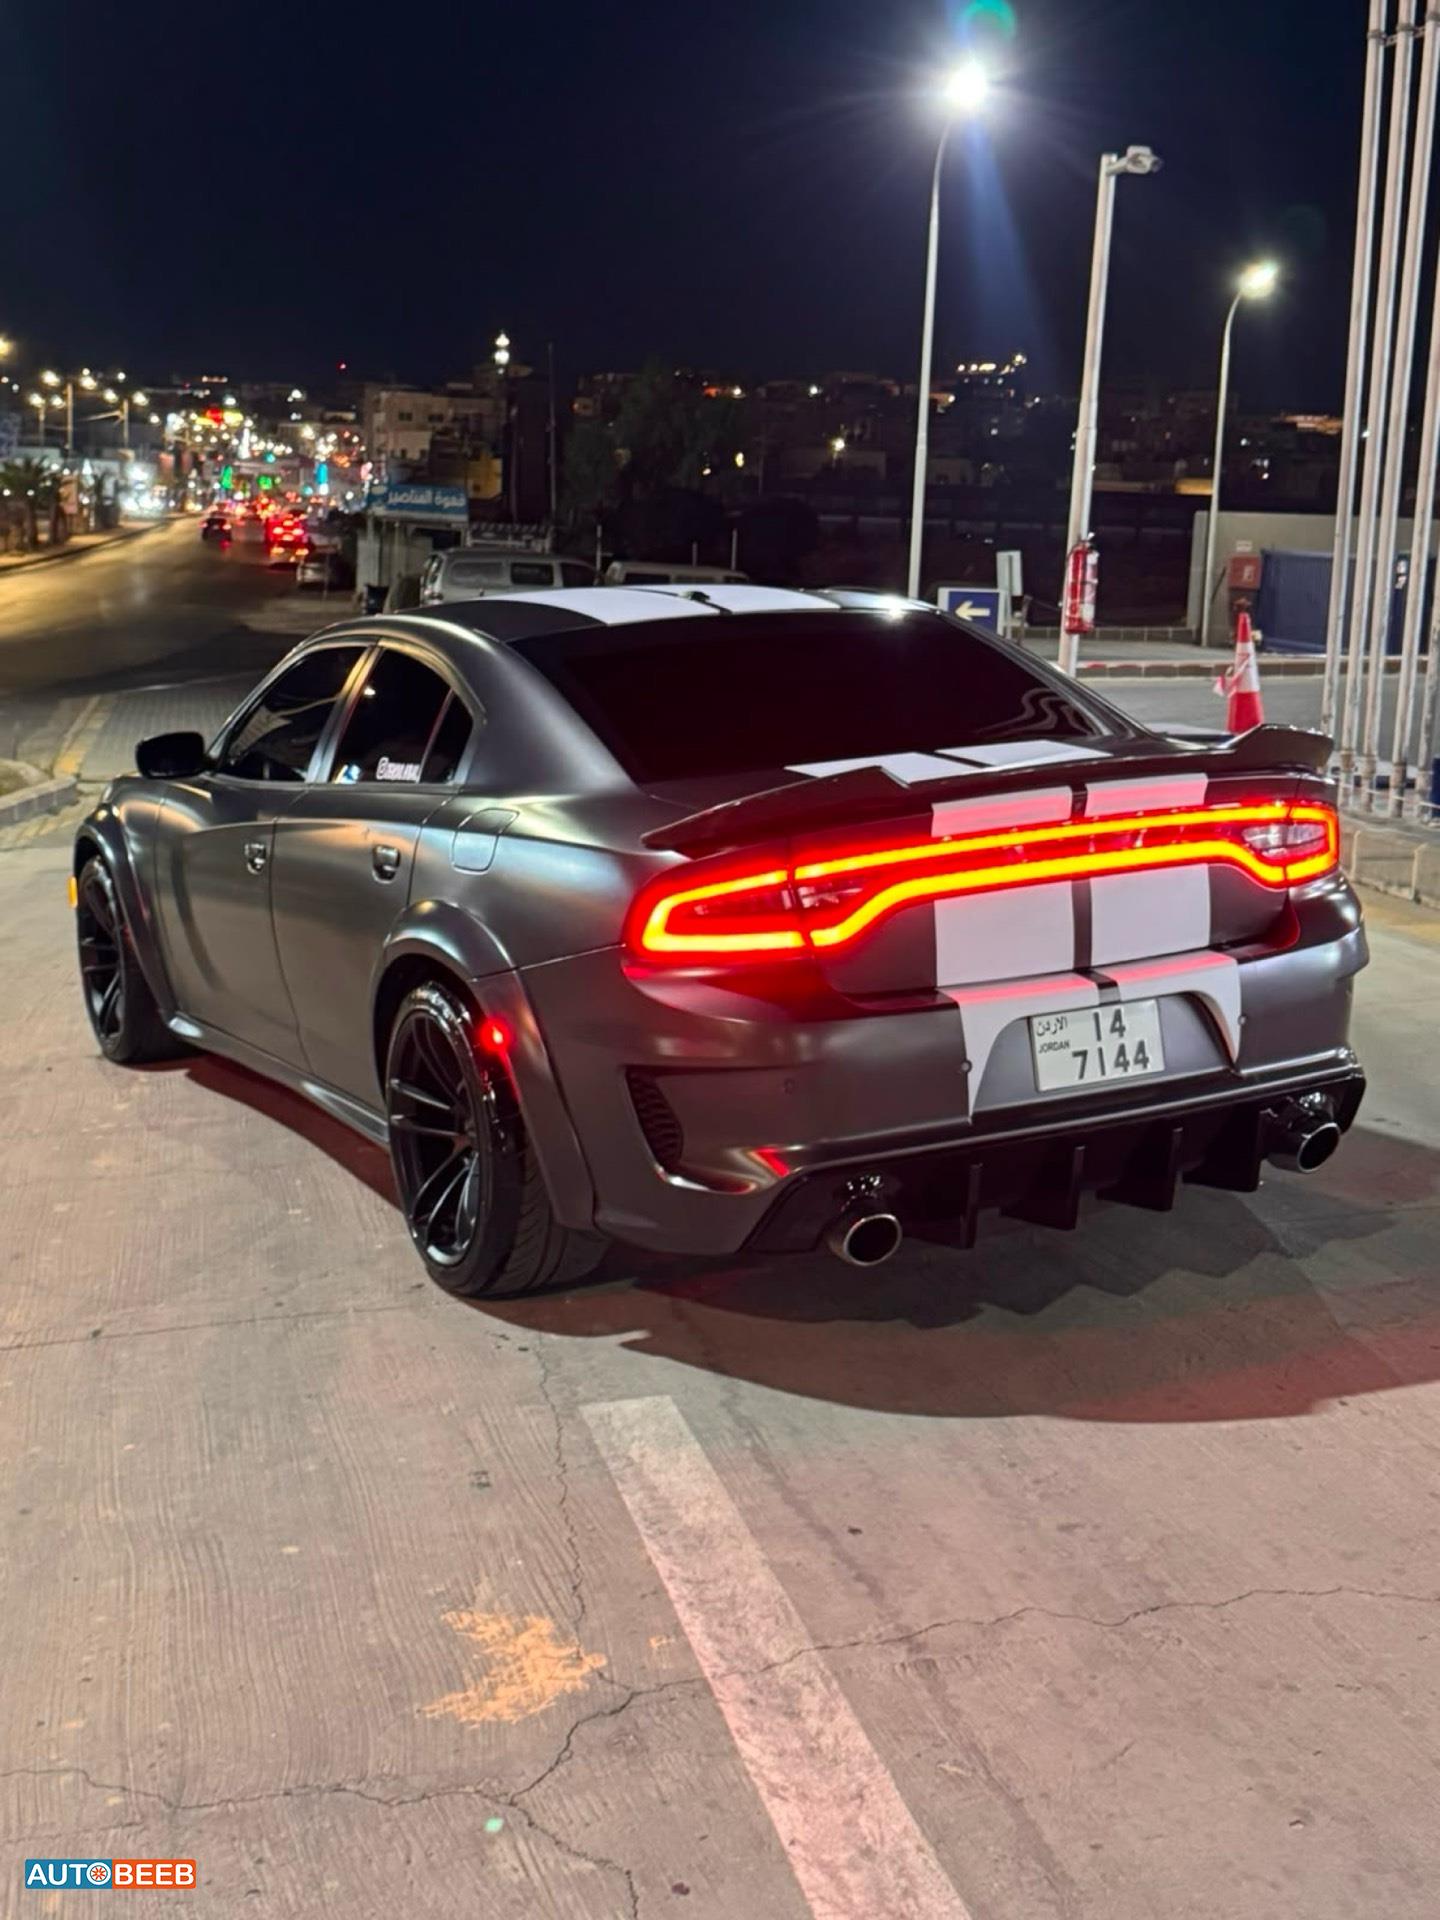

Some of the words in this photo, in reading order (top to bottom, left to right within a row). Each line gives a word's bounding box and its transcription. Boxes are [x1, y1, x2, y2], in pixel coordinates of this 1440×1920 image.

[1092, 1008, 1127, 1042] 14
[1038, 1039, 1070, 1054] JORDAN
[1071, 1039, 1150, 1080] 7144
